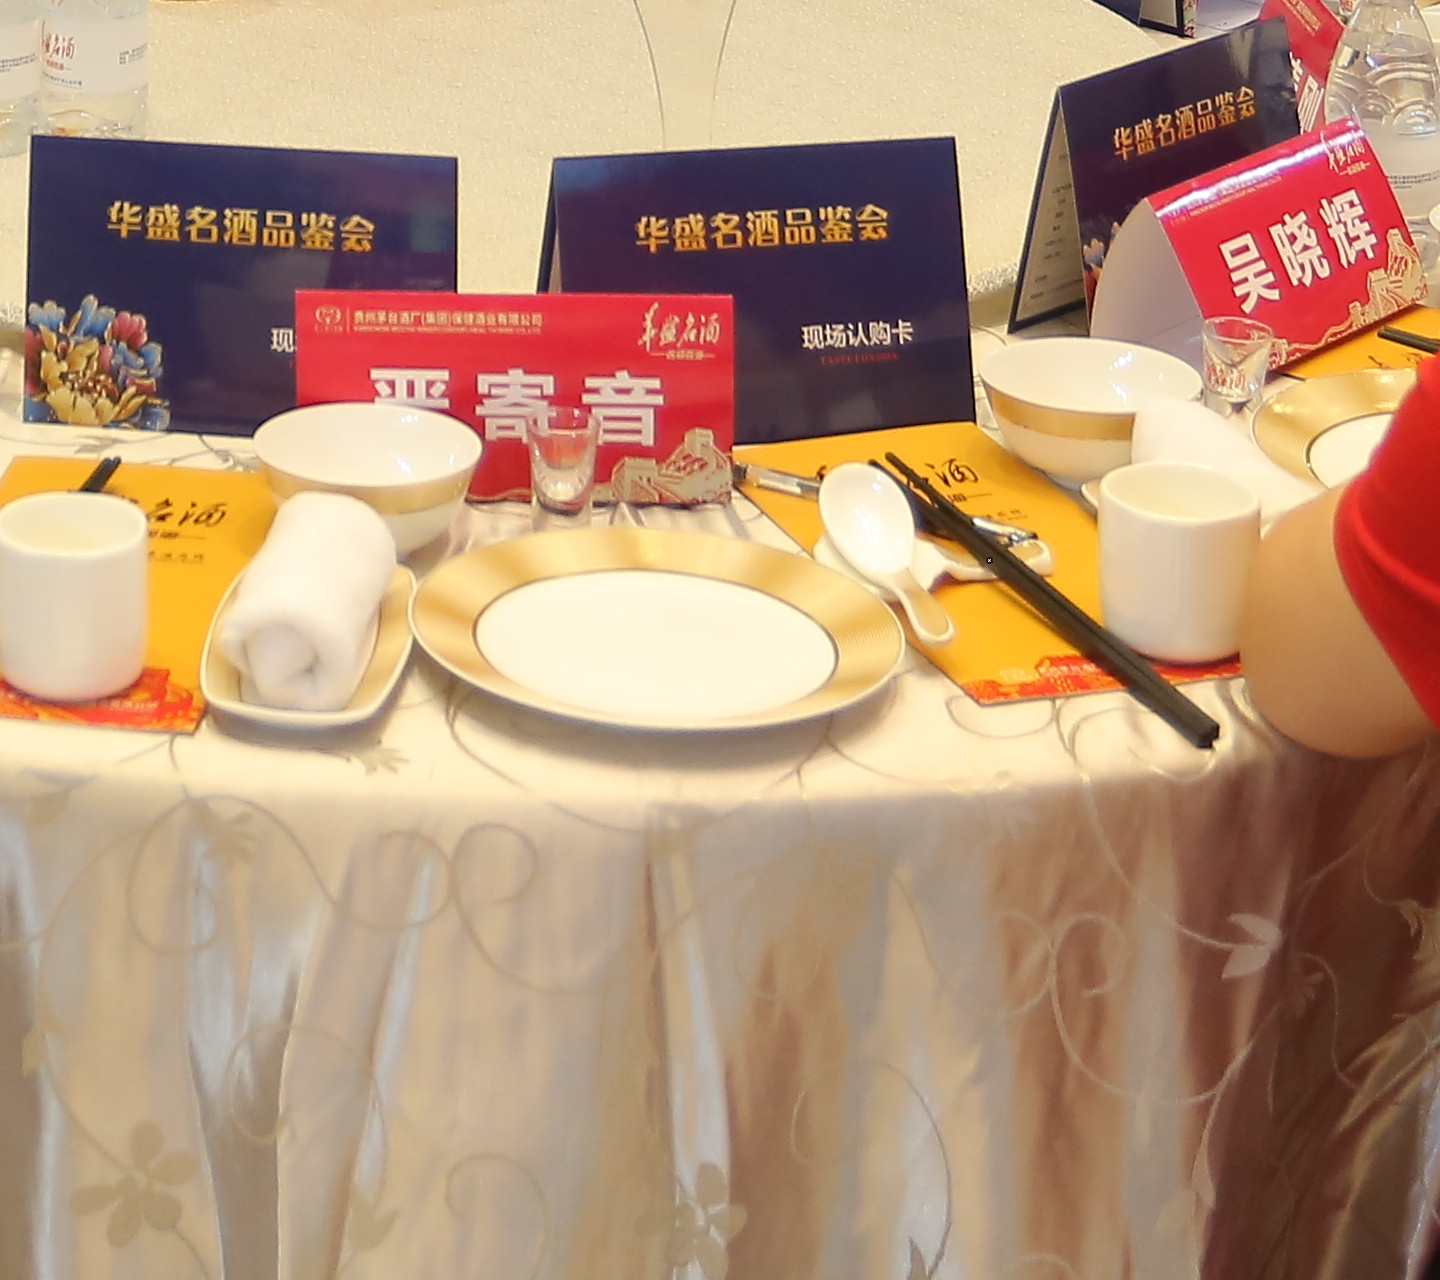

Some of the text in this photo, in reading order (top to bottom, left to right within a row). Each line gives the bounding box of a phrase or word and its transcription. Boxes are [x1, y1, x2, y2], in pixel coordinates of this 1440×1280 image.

[1112, 85, 1258, 162] 华盛名酒品鉴会
[106, 200, 377, 253] 华盛名酒品鉴会
[634, 202, 890, 254] 华盛名酒品鉴会
[1218, 189, 1379, 314] 吴晓辉
[801, 319, 914, 350] 现场认购卡
